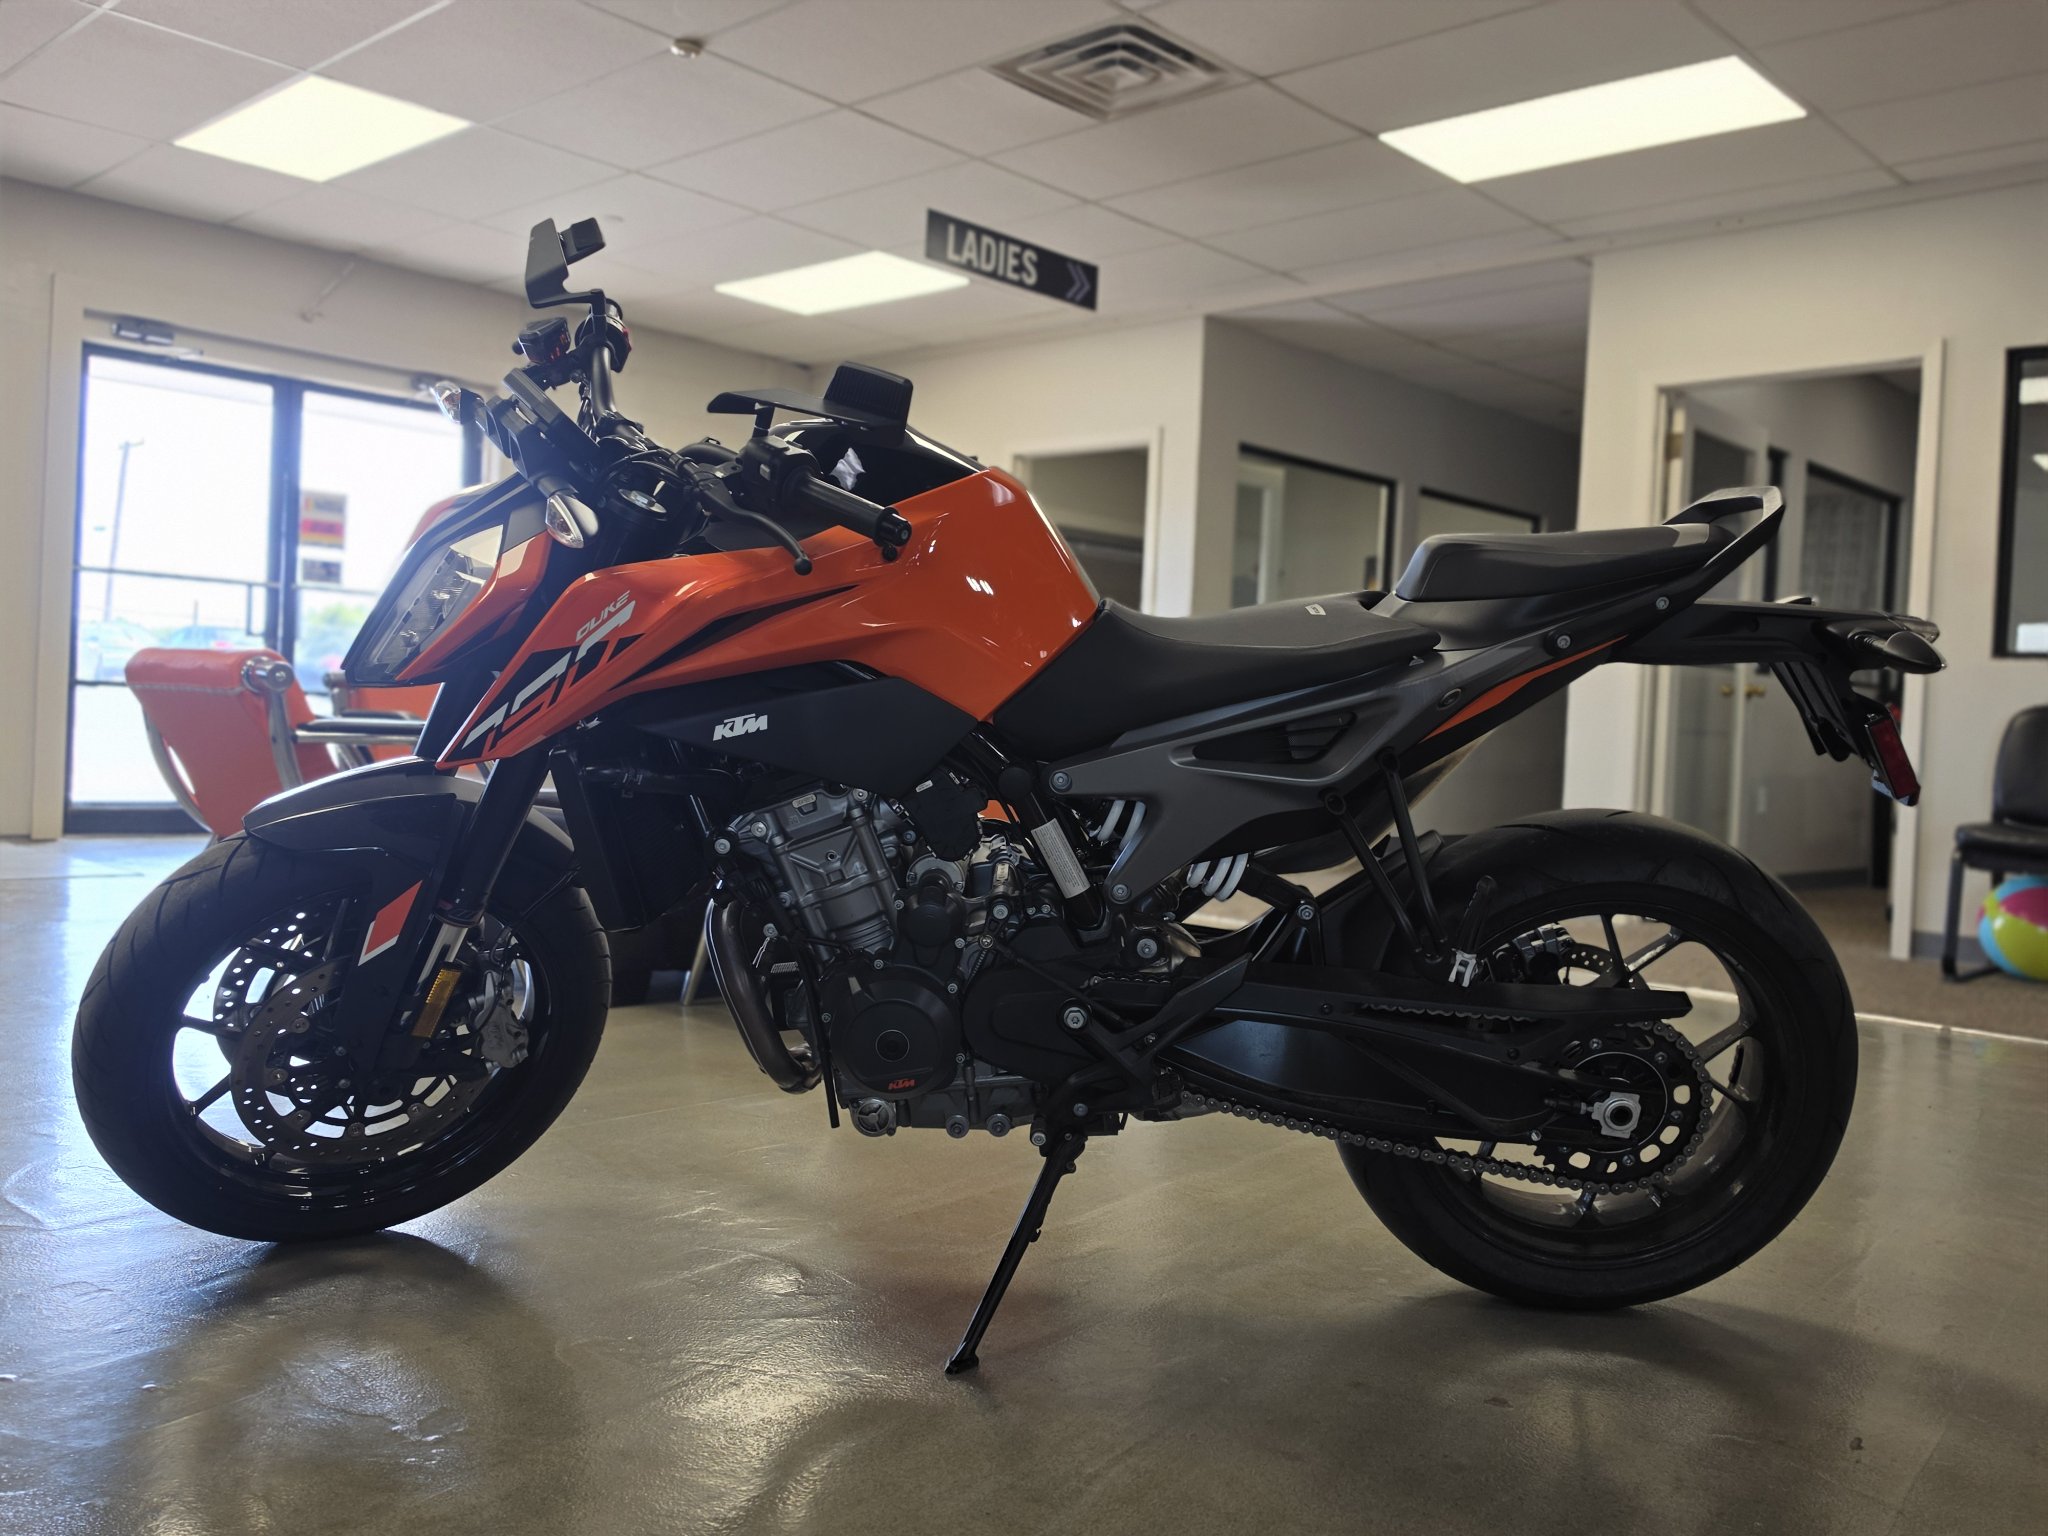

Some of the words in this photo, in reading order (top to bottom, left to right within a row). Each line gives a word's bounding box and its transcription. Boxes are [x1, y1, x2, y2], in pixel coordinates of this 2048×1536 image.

[946, 223, 1039, 286] LADIES
[576, 590, 631, 642] DUKE
[713, 713, 768, 741] KTM
[888, 1078, 915, 1090] KTM
